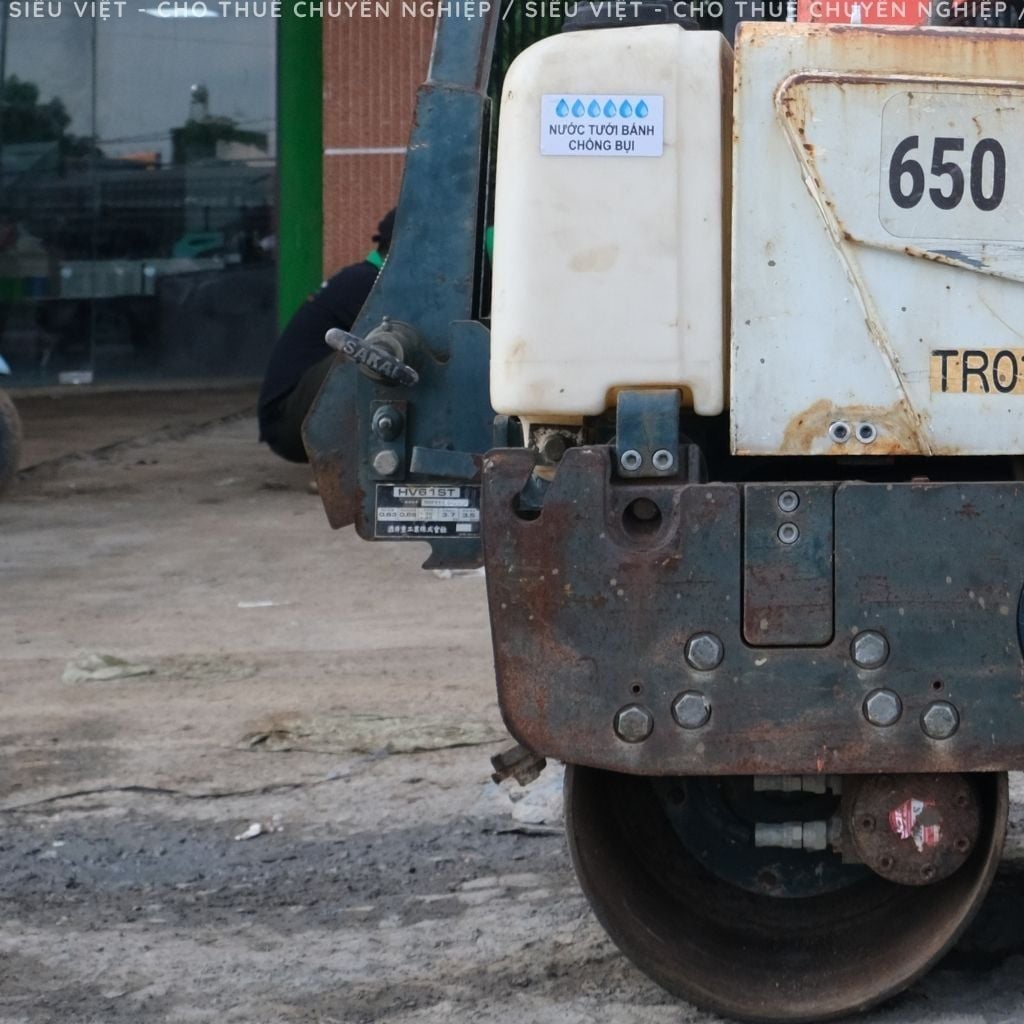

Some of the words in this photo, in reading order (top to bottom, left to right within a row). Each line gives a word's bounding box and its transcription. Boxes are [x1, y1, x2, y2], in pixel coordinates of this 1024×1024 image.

[549, 122, 585, 135] NƯỚC
[621, 123, 655, 136] BÁNH
[568, 137, 612, 151] CHỐNG
[615, 140, 635, 154] BỤI
[888, 135, 1006, 211] 650
